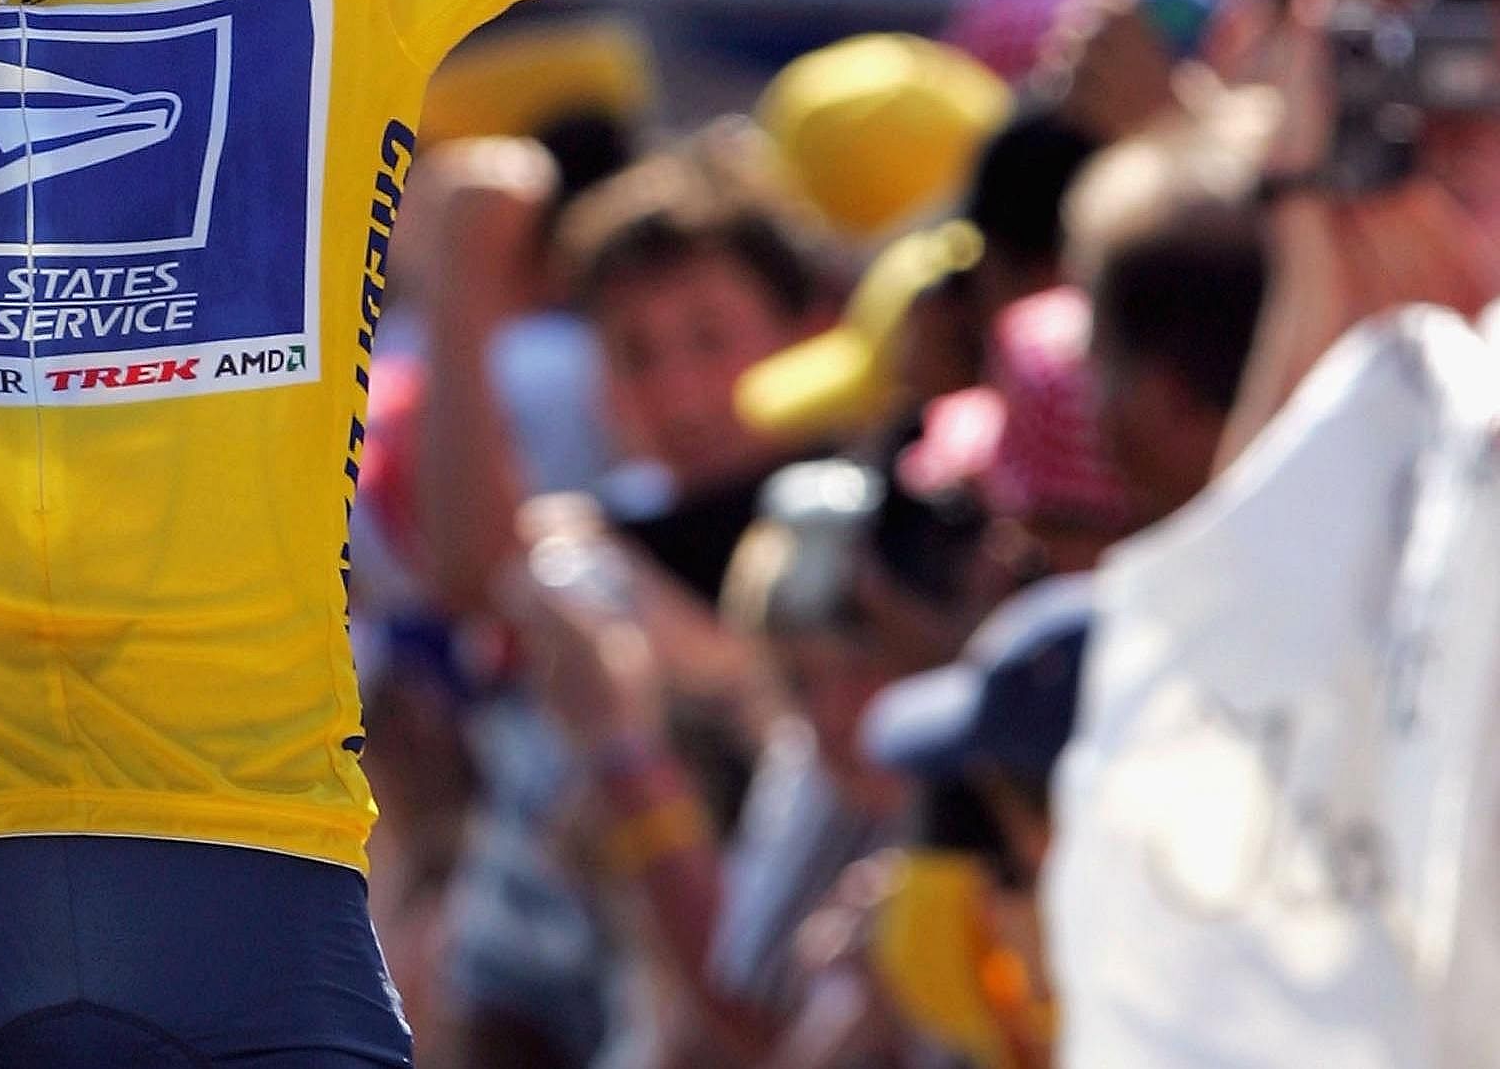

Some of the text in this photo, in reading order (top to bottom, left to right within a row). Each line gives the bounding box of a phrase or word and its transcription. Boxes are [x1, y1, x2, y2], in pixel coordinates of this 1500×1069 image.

[2, 262, 180, 301] STATES
[43, 357, 201, 393] TREK
[214, 348, 284, 378] AMD
